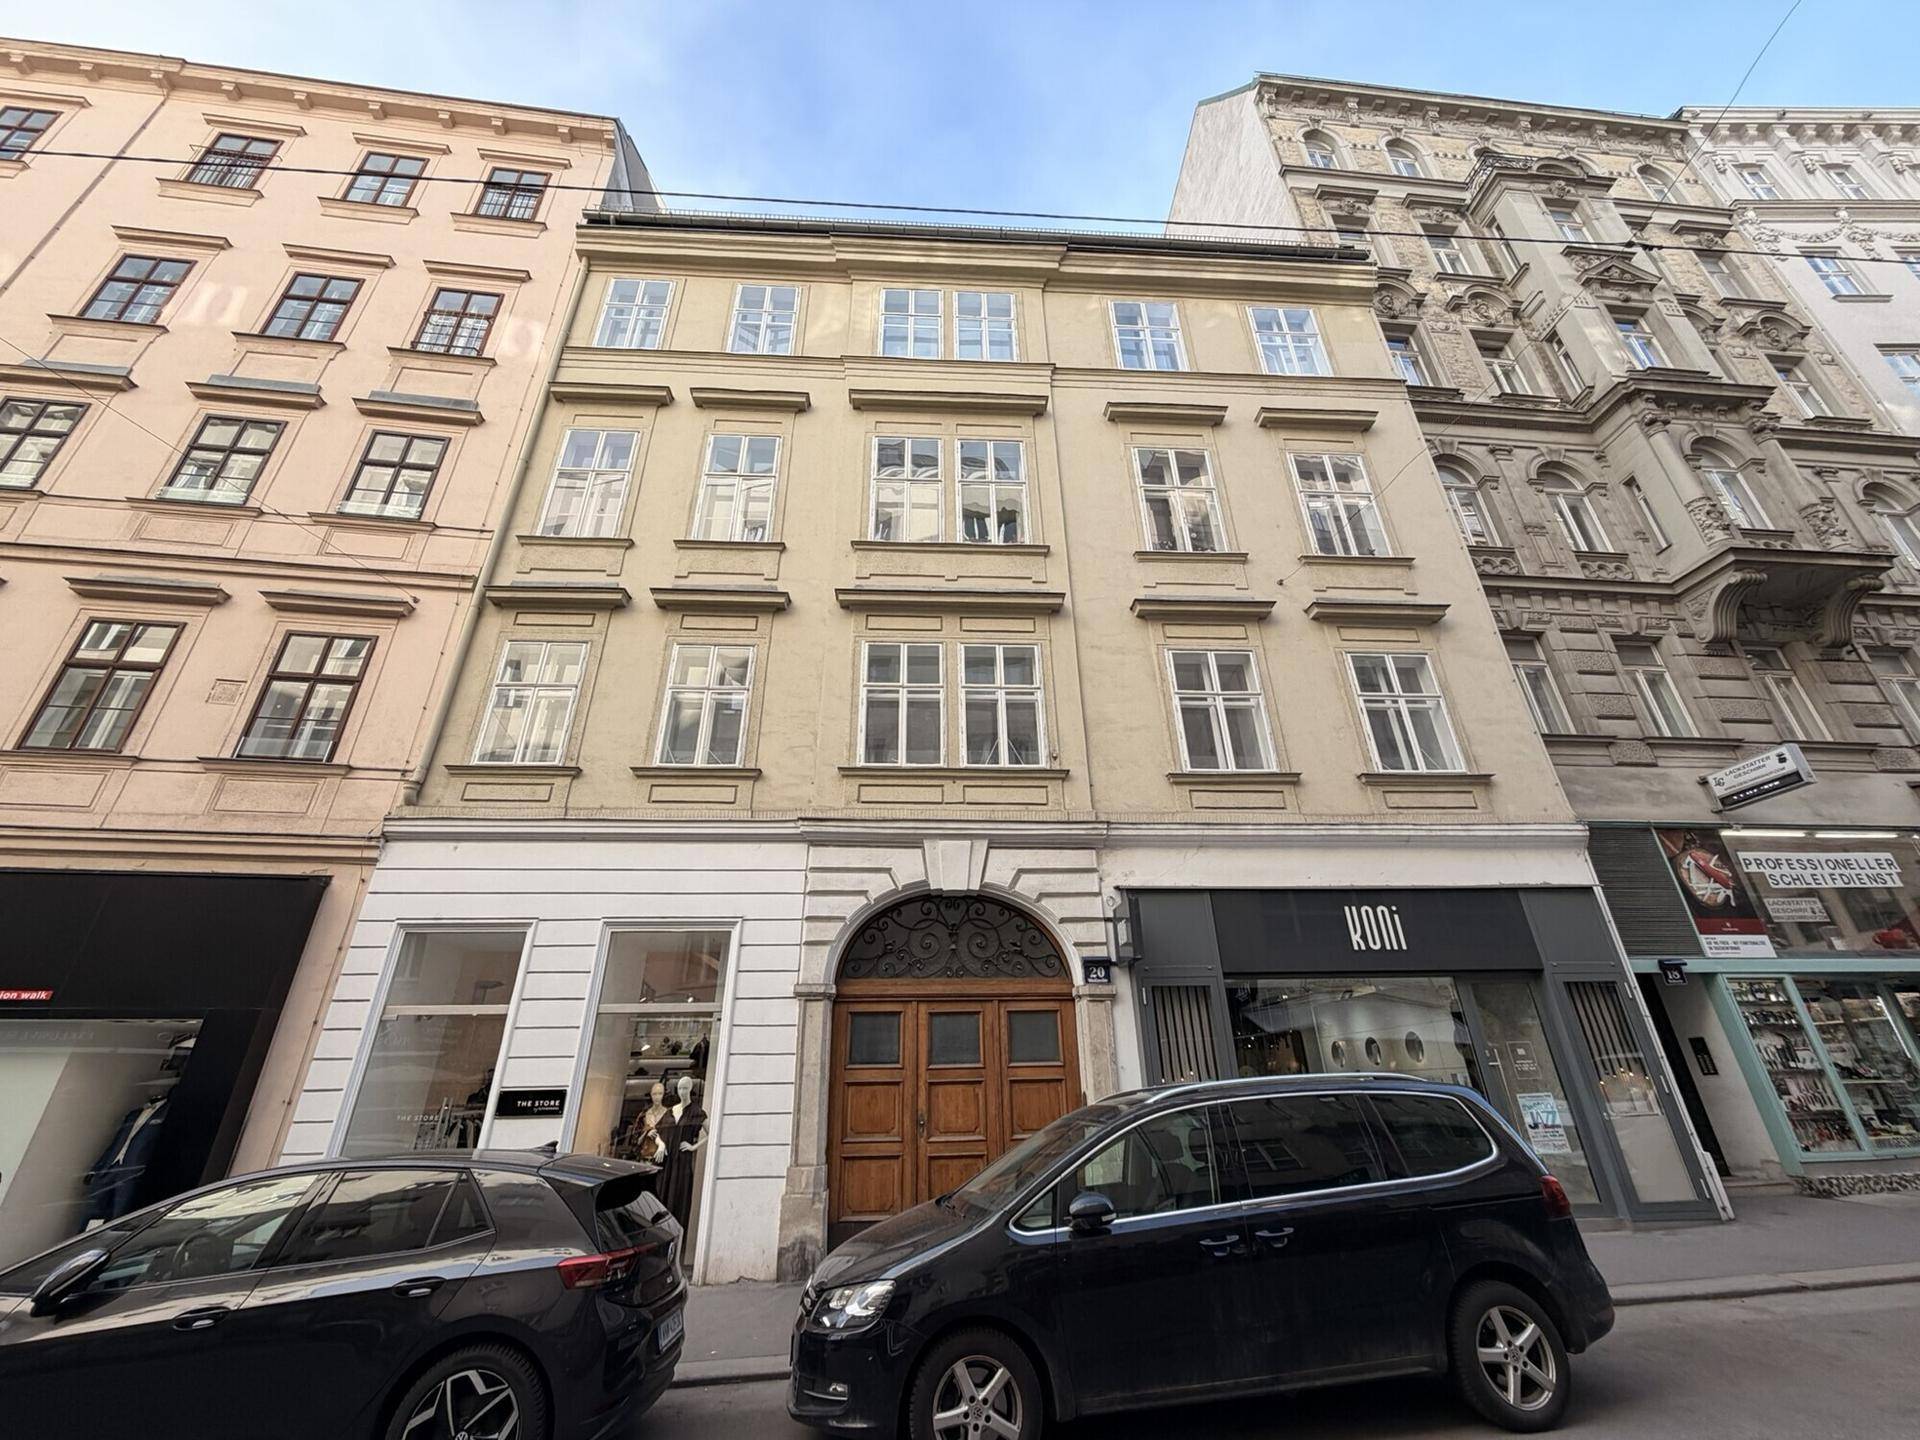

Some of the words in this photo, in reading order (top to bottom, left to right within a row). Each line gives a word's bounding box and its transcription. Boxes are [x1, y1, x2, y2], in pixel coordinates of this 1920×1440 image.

[1742, 857, 1899, 872] PROFESSIONELLER
[1089, 966, 1106, 978] 20
[20, 990, 47, 1000] walk
[517, 1100, 533, 1108] THE
[534, 1099, 561, 1107] STORE
